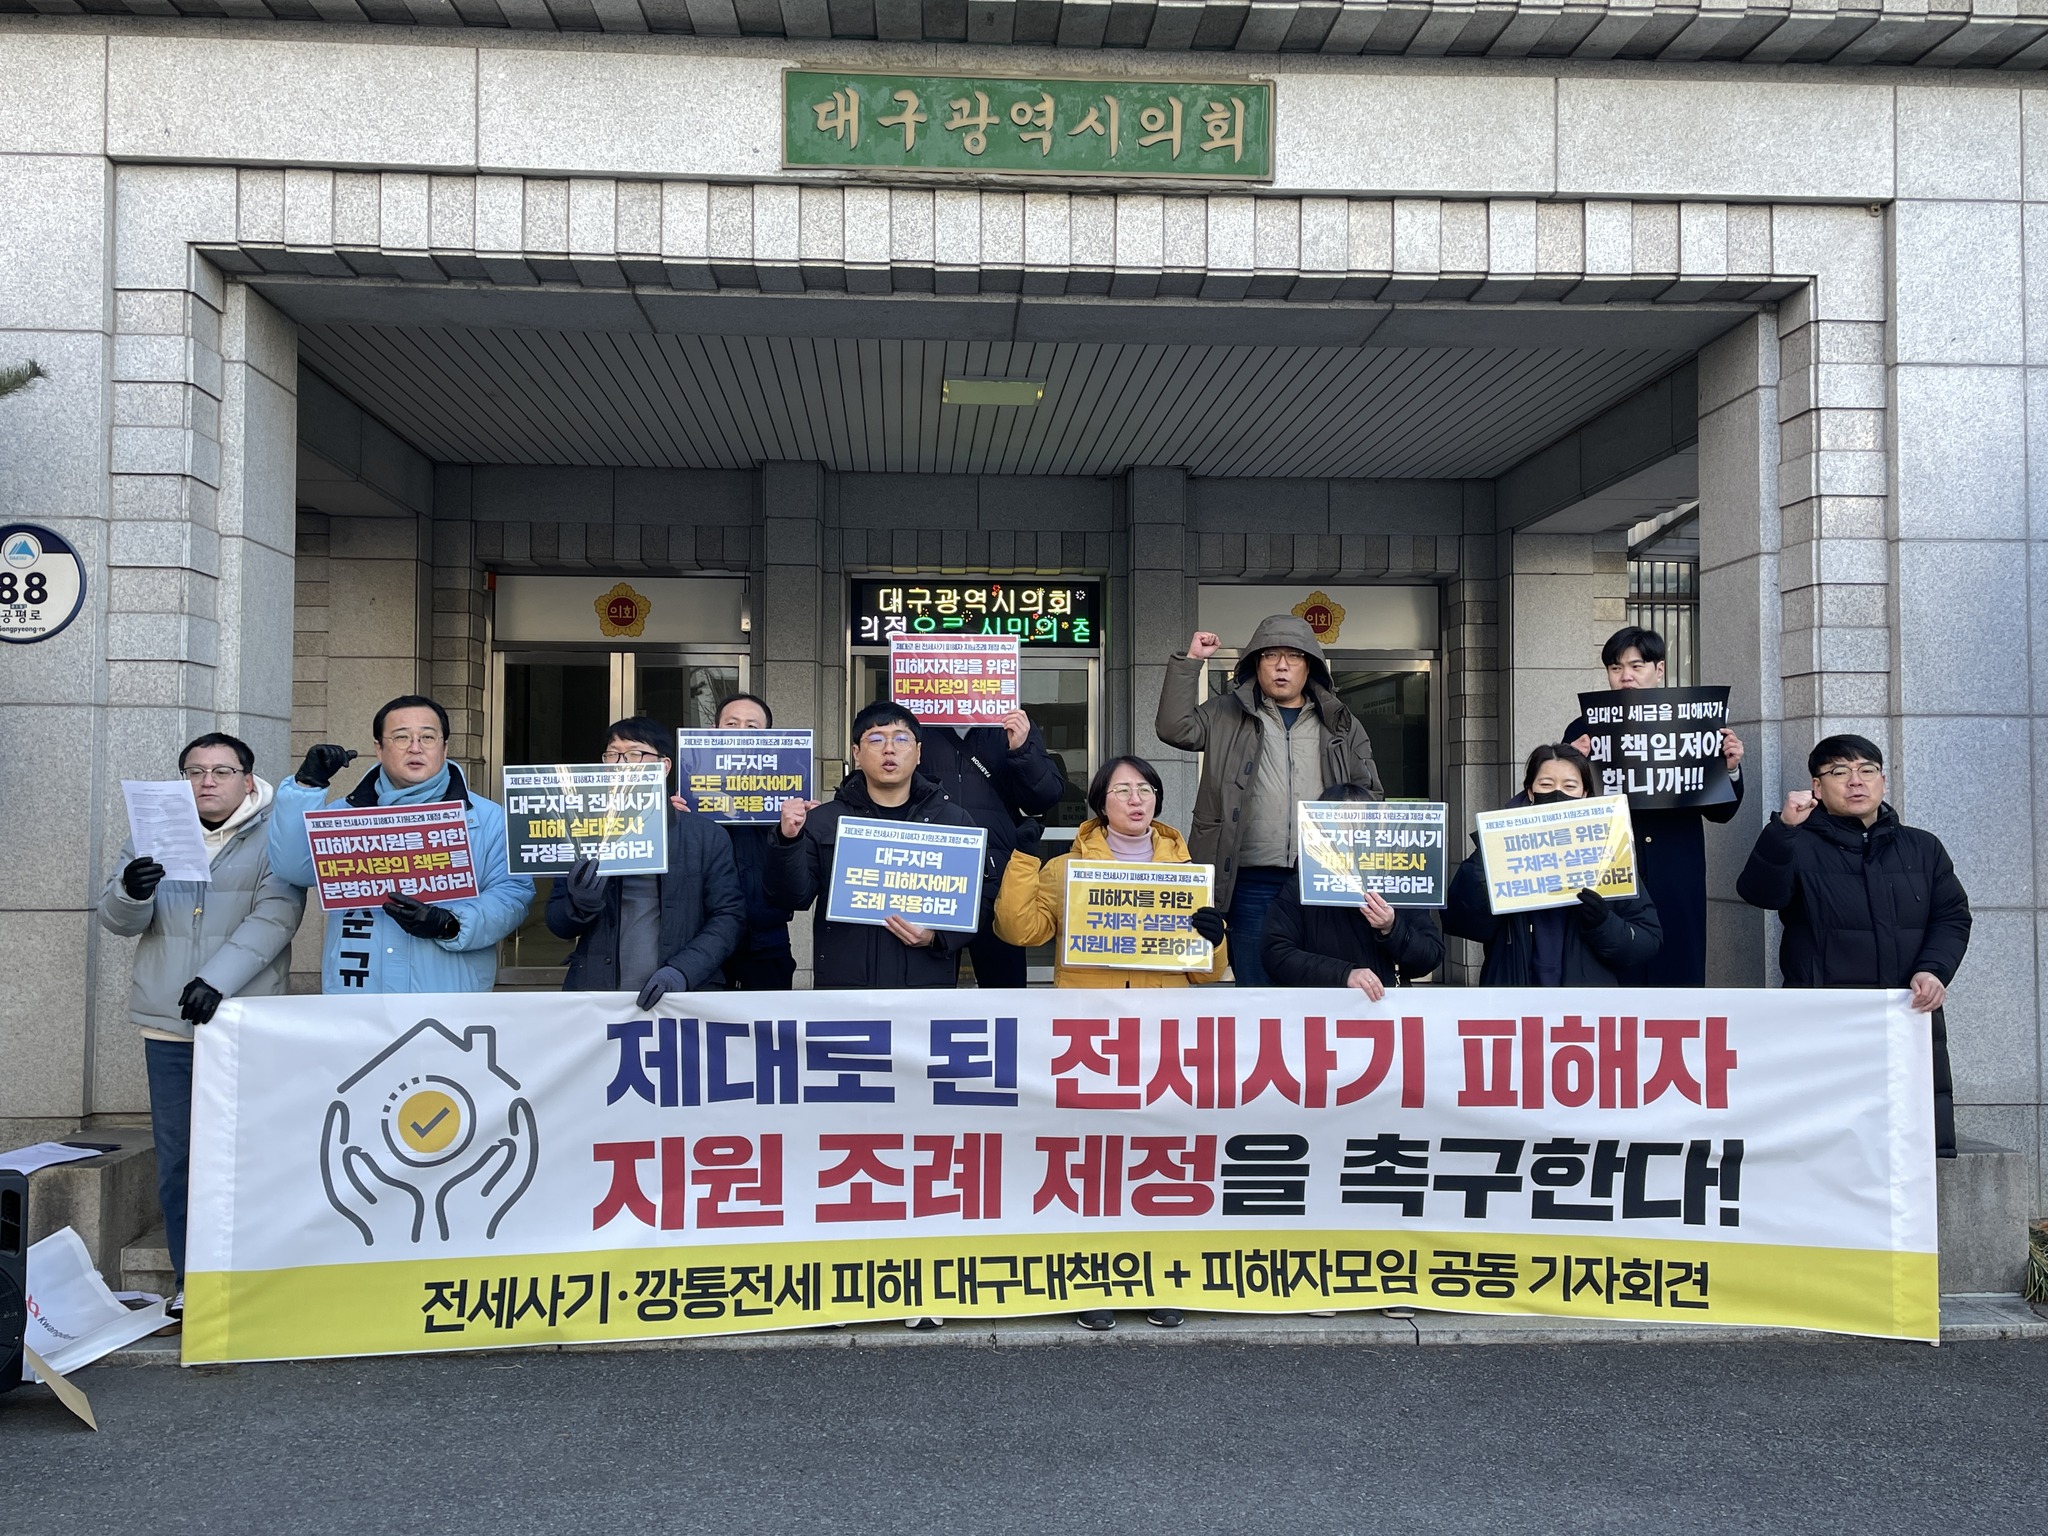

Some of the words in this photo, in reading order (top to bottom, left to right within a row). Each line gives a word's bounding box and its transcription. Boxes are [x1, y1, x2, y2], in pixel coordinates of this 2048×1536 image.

[812, 87, 1246, 163] 대구광역시의회
[609, 605, 636, 619] 의회
[879, 587, 1072, 615] 대구광역시의회
[0, 610, 42, 624] 공평로
[1306, 612, 1331, 627] 의회
[895, 659, 982, 675] 피해자지원을
[986, 659, 1016, 675] 위한
[895, 679, 968, 695] 대구시장의
[971, 679, 1016, 695] 책무를
[957, 699, 1017, 715] 명시하라
[1586, 705, 1624, 724] 임대인
[1628, 703, 1673, 722] 세금을
[1677, 701, 1724, 720] 피해자가
[1590, 735, 1612, 762] 왜
[1620, 730, 1724, 762] 책임져야
[715, 754, 778, 771] 대구지역
[690, 775, 721, 792] 모든
[725, 774, 802, 792] 피해자에게
[1602, 767, 1704, 796] 합니까!!!
[509, 794, 584, 815] 대구지역
[588, 791, 661, 813] 전세사기
[697, 796, 730, 813] 조례
[733, 796, 794, 812] 적용하
[528, 819, 566, 839] 피해
[570, 816, 645, 837] 실태조사
[1375, 830, 1442, 848] 전세사기
[1503, 828, 1573, 852] 피해자를
[1575, 823, 1610, 842] 위한
[313, 831, 424, 856] 피해자지원을
[427, 827, 466, 848] 위한
[520, 843, 576, 863] 규정을
[580, 840, 654, 861] 포함하라
[318, 855, 410, 878] 대구시장의
[412, 850, 470, 872] 책무를
[874, 847, 943, 869] 대구지역
[1321, 852, 1354, 870] 해
[1358, 853, 1427, 871] 실태조사
[323, 879, 396, 900] 분명하게
[399, 872, 474, 896] 명시하라
[844, 867, 880, 888] 모든
[883, 871, 967, 894] 피해자에게
[1366, 875, 1435, 894] 포함하라
[1494, 875, 1562, 898] 지원내용
[850, 891, 886, 911] 조례
[889, 894, 957, 916] 적용하라
[1088, 889, 1155, 908] 피해자를
[1159, 891, 1193, 909] 위한
[1070, 935, 1136, 954] 지원내용
[1141, 937, 1209, 957] 포함하라
[606, 1017, 895, 1108] 제대로
[927, 1017, 1019, 1107] 된
[1051, 1016, 1425, 1110] 전세사기
[1457, 1015, 1738, 1110] 피해자
[592, 1133, 784, 1232] 지원
[815, 1132, 1002, 1223] 조례
[1033, 1133, 1310, 1217] 제정을
[1340, 1132, 1744, 1227] 촉구한다!
[832, 1258, 922, 1309] 피해
[933, 1251, 1154, 1305] 대구대책위
[1201, 1248, 1418, 1299] 피해자모임
[1429, 1250, 1518, 1299] 공동
[1529, 1254, 1709, 1310] 기자회견
